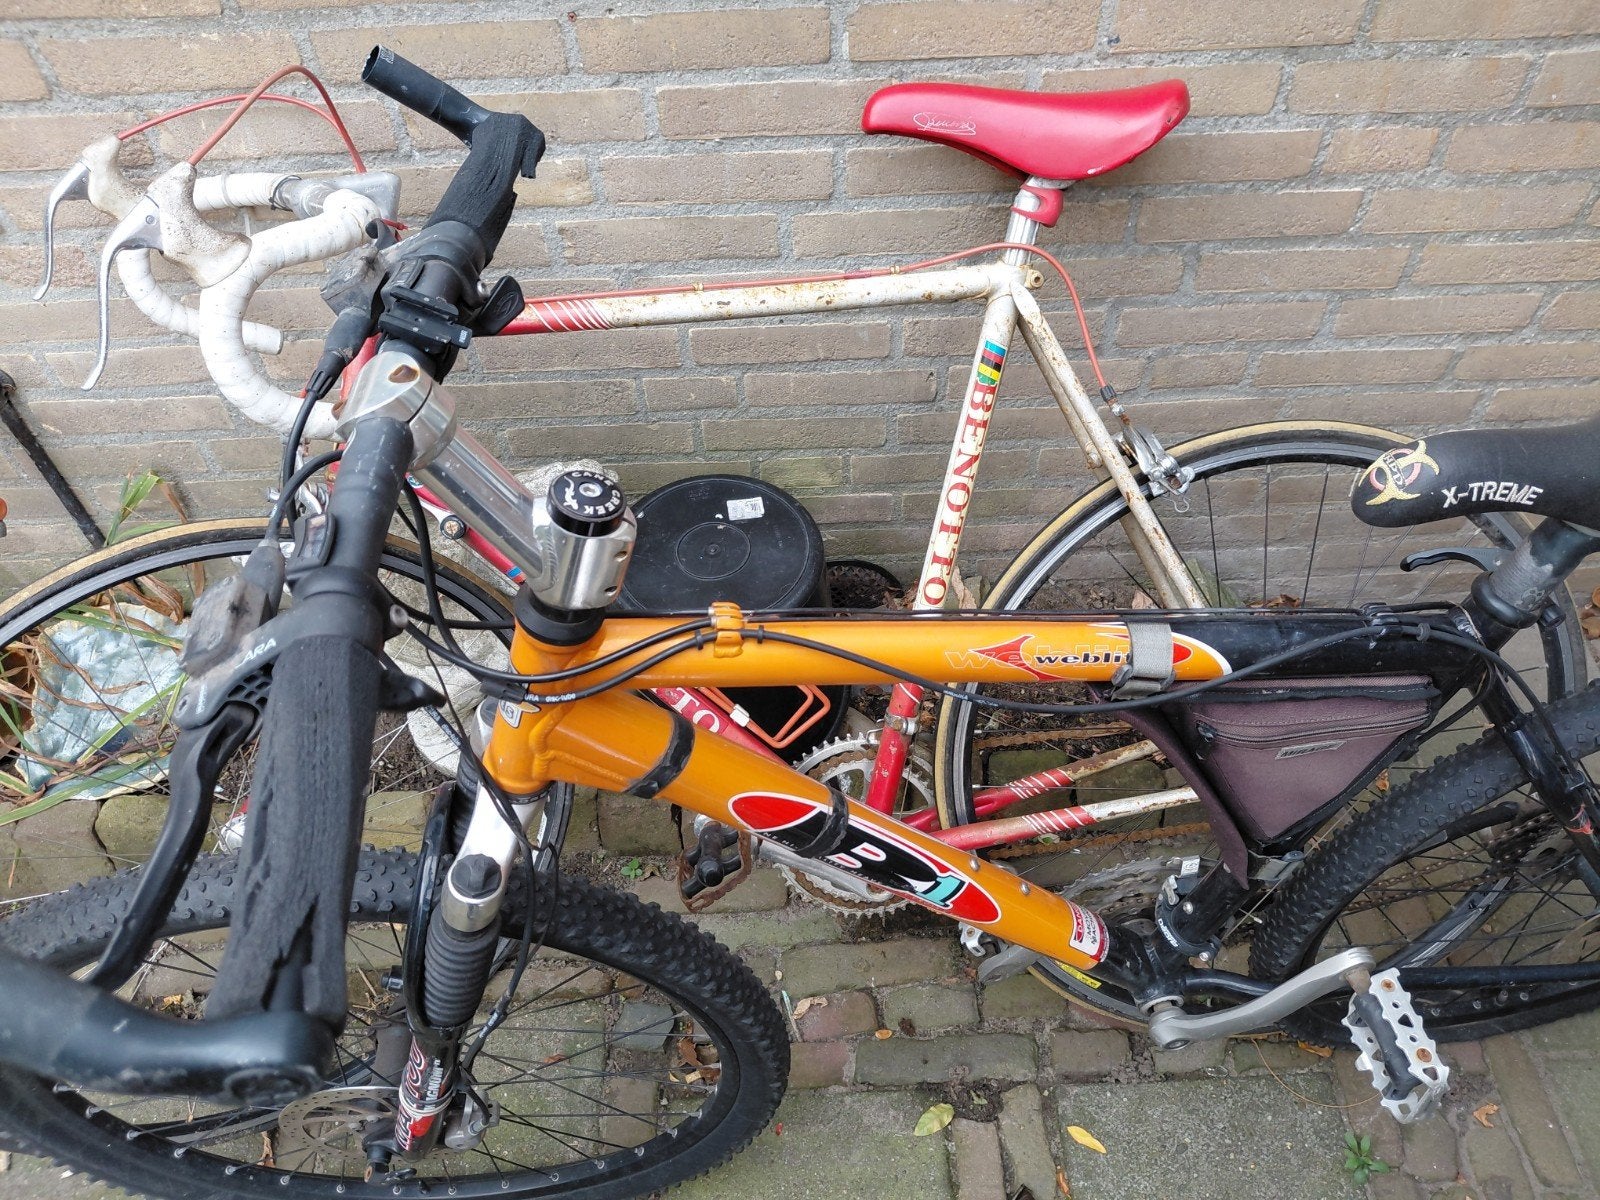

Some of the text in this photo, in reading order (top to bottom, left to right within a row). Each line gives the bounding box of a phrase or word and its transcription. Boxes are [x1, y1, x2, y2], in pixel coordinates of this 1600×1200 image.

[572, 471, 620, 514] CANE CREEK
[924, 382, 997, 604] BENOTTO
[1441, 481, 1544, 508] X-TREME
[1034, 652, 1131, 665] weblit
